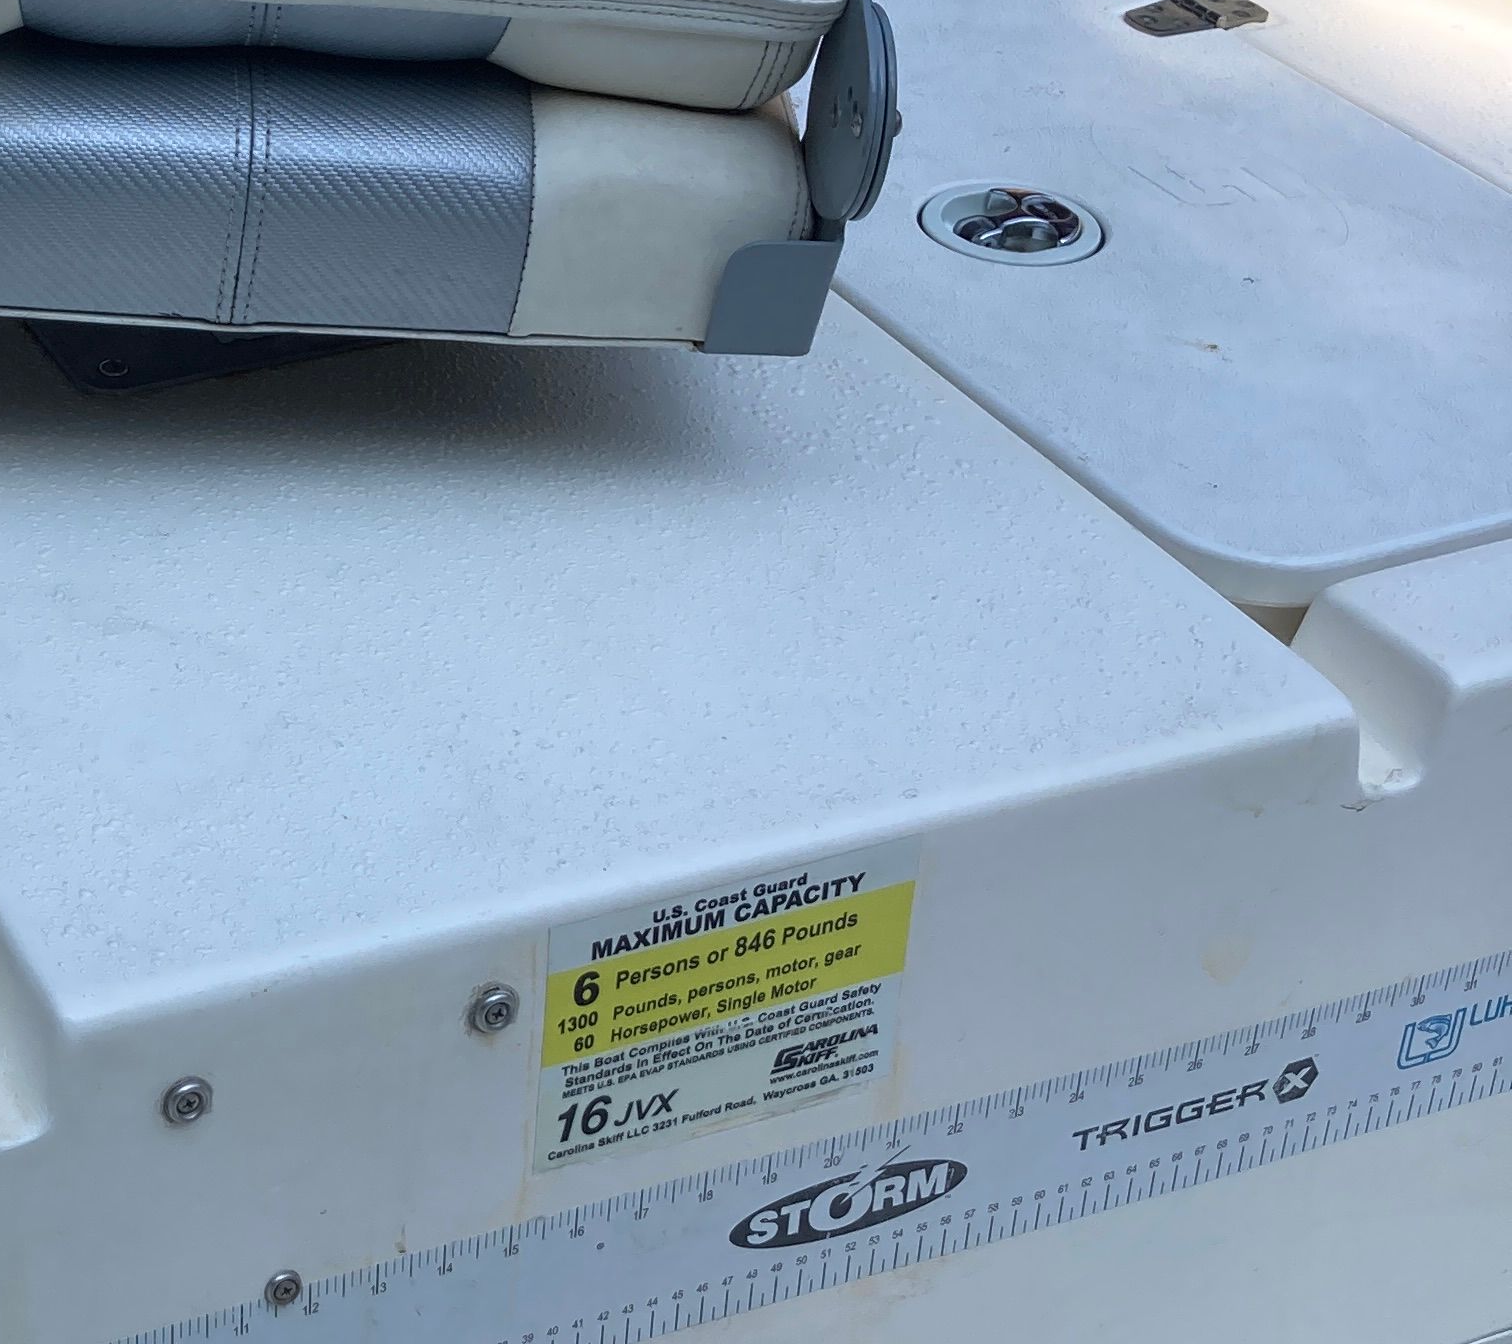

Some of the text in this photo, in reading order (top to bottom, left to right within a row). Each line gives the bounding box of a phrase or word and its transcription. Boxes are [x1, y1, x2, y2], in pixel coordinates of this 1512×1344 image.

[592, 871, 867, 961] MAXIMUM CAPACITY
[653, 872, 808, 923] U.S. Coast Guard
[557, 944, 862, 1035] 1300 Pounds, persons, motor, gear
[573, 912, 858, 1006] 6 Persons or 846 Pounds
[561, 1060, 591, 1077] This
[594, 1052, 625, 1069] Boat
[628, 1033, 690, 1058] Complies
[758, 1004, 796, 1023] Coast
[799, 993, 838, 1012] Guard
[841, 982, 882, 1001] Safety
[562, 1007, 875, 1100] MEETS U.S. EPA EVAP STANDARDS USING CERTIFIED COMPONENTS.
[565, 1063, 633, 1088] Standards
[652, 1045, 691, 1064] Effect
[694, 1041, 713, 1053] On
[718, 1031, 741, 1047] The
[744, 1024, 772, 1040] Date
[777, 1019, 791, 1031] of
[574, 1034, 595, 1052] 60
[610, 1006, 711, 1042] Horsepower,
[716, 990, 766, 1014] Single
[771, 977, 817, 1000] Motor
[774, 1024, 879, 1068] CAROLINA
[769, 1049, 879, 1085] www.carolinaskiff.com
[547, 1140, 595, 1161] Carolina
[598, 1132, 625, 1147] Skiff
[626, 1125, 650, 1139] LLC
[652, 1118, 678, 1132] 3231
[681, 1104, 722, 1124] Fulford
[763, 1079, 816, 1102] Waycross
[558, 1088, 680, 1143] 16 JVX
[1072, 1079, 1270, 1151] TRIGGER
[746, 1161, 951, 1245] STORM
[233, 1322, 249, 1337] 11
[302, 1302, 320, 1316] 12
[370, 1281, 387, 1296] 13
[437, 1262, 453, 1276] 14
[503, 1243, 519, 1258] 15
[568, 1225, 585, 1239] 16
[634, 1207, 650, 1221] 17
[697, 1189, 714, 1203] 18
[761, 1172, 778, 1185] 19
[823, 1155, 841, 1169] 20
[546, 1325, 559, 1336] 40
[597, 1310, 610, 1321] 42
[646, 1296, 658, 1308] 44
[696, 1282, 709, 1293] 46
[795, 1255, 808, 1266] 50
[845, 1241, 857, 1253] 52
[892, 1228, 903, 1240] 54
[940, 1214, 952, 1226] 56
